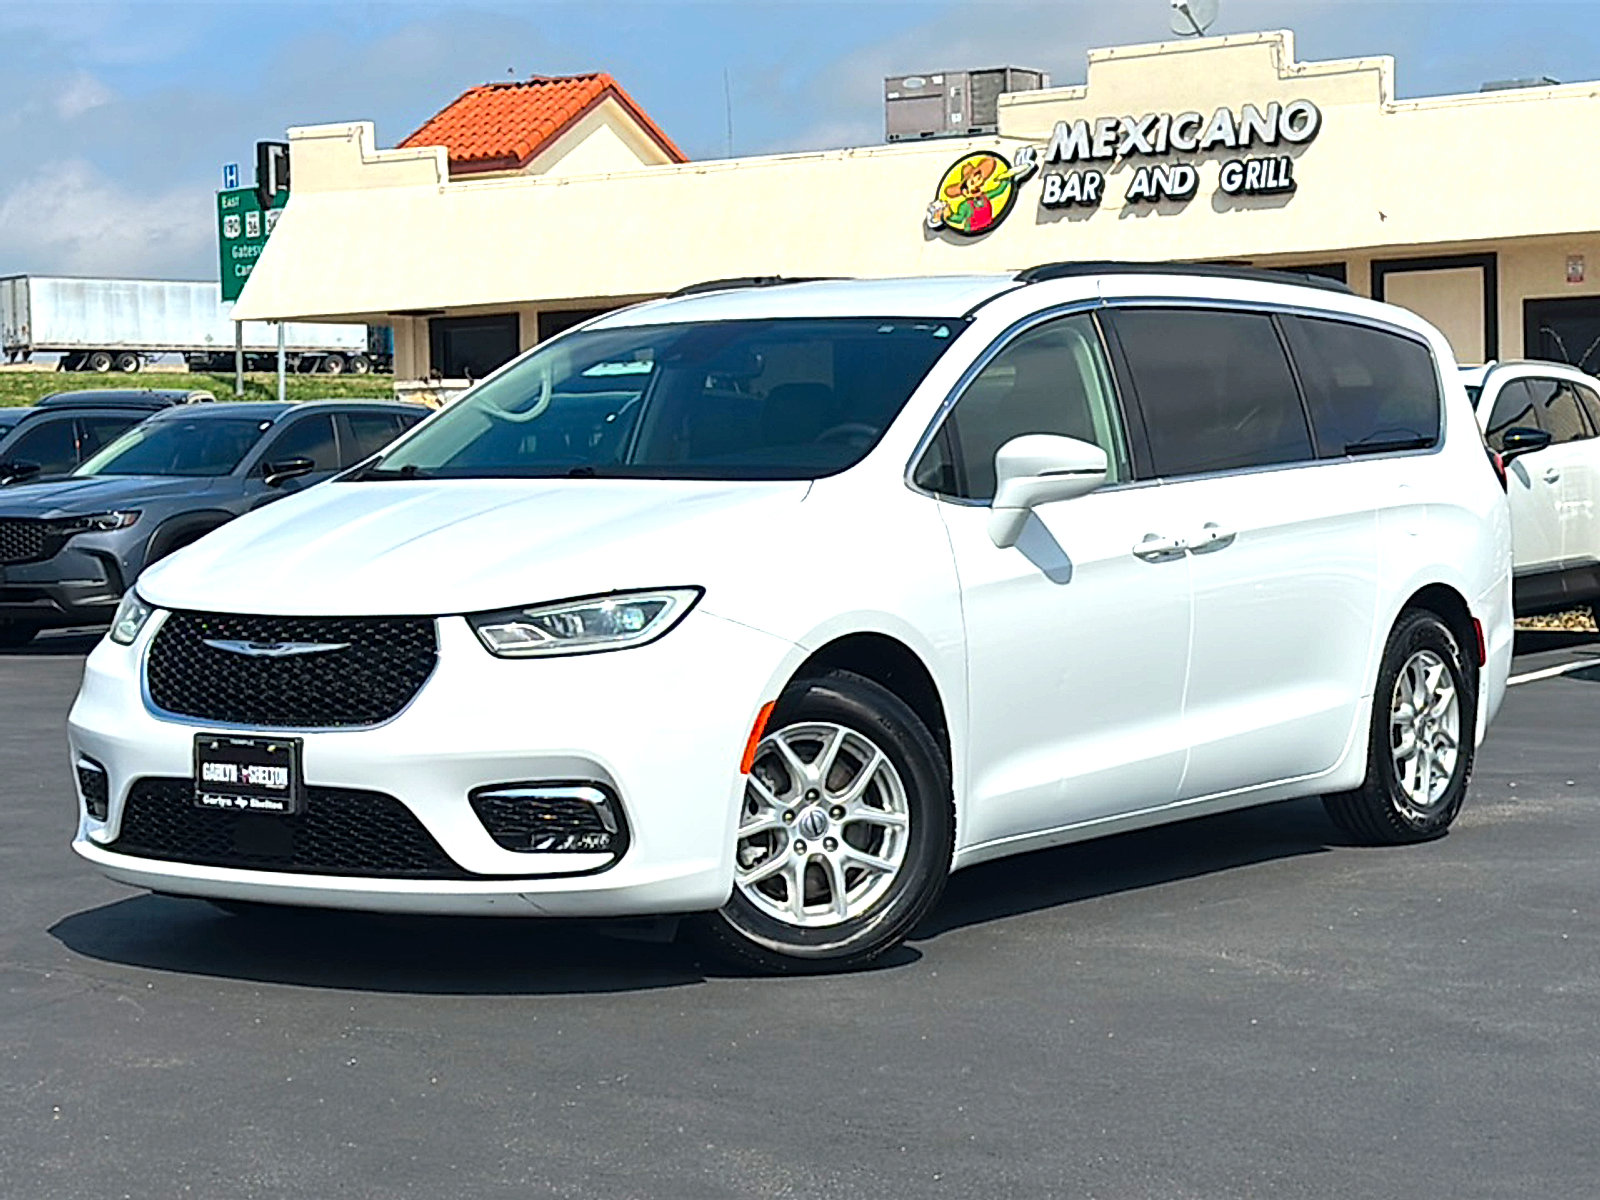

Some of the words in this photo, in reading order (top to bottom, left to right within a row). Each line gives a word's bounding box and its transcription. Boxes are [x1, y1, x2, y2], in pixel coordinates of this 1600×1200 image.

[1044, 99, 1320, 162] MEXICANO
[1042, 171, 1101, 204] BAR
[1126, 165, 1196, 198] AND
[1220, 158, 1290, 192] GRILL
